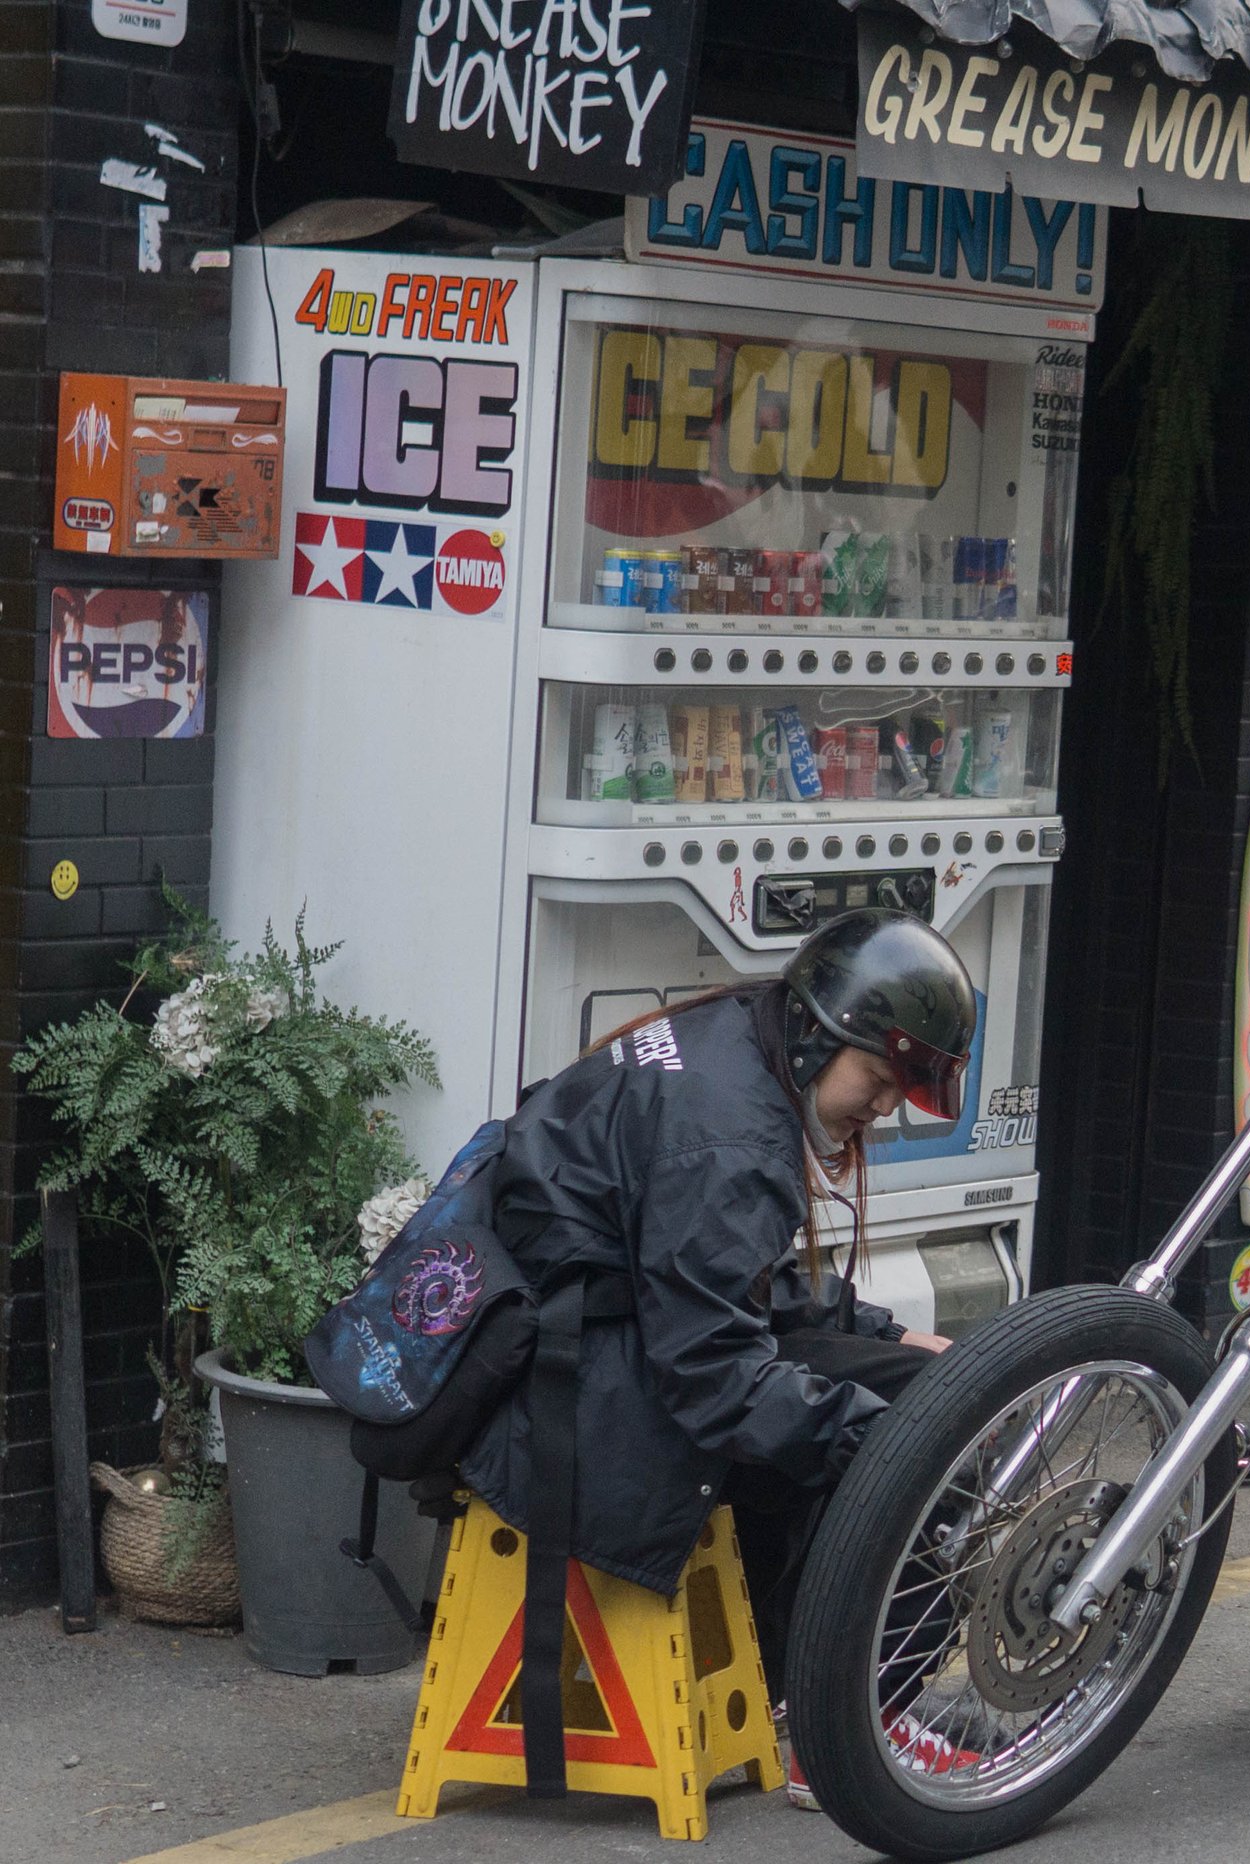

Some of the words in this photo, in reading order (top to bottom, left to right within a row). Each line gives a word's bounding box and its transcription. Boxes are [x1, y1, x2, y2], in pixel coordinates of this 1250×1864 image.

[406, 35, 668, 171] MONKEY
[864, 44, 1114, 163] GREASE
[647, 133, 876, 268] CASH
[889, 177, 1094, 296] ONLY!
[377, 273, 518, 345] FREAK
[314, 349, 518, 519] ICE
[588, 325, 717, 483] CE
[725, 343, 953, 495] COLD
[437, 555, 503, 590] TAMIYA
[59, 642, 197, 685] PEPSI
[964, 1186, 1014, 1207] SAMSUNG
